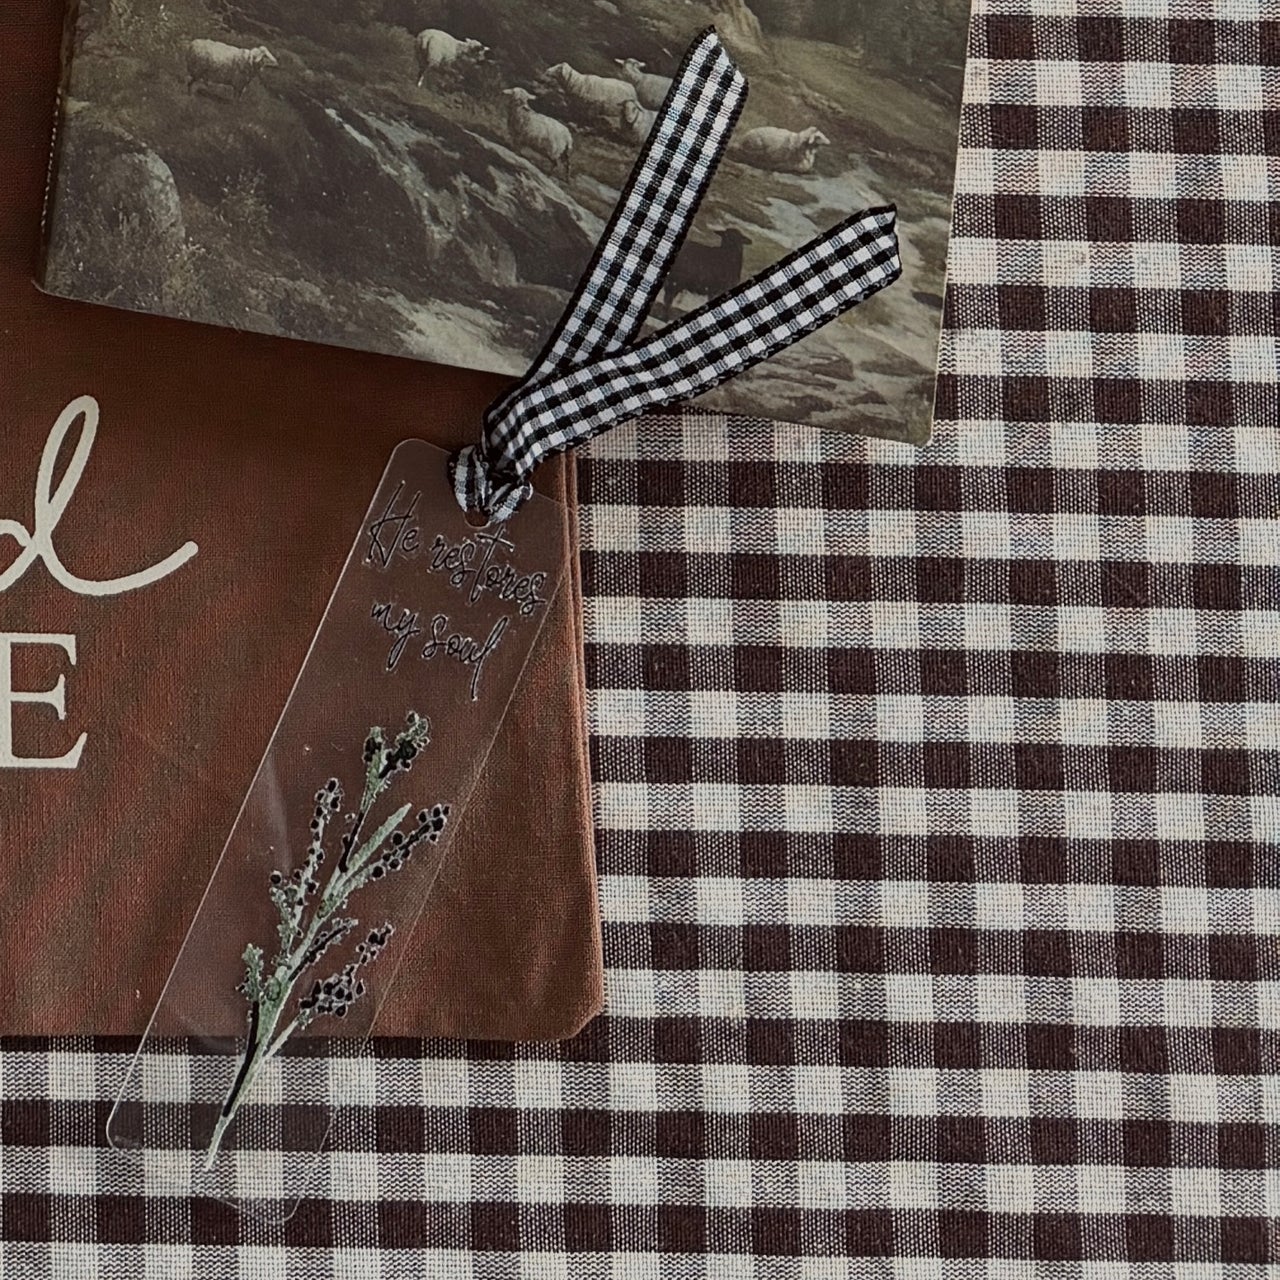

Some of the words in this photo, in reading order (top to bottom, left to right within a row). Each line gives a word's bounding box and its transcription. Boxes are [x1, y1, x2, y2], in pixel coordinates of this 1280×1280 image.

[362, 480, 420, 568] He
[426, 523, 548, 616] restores
[371, 600, 421, 671] my
